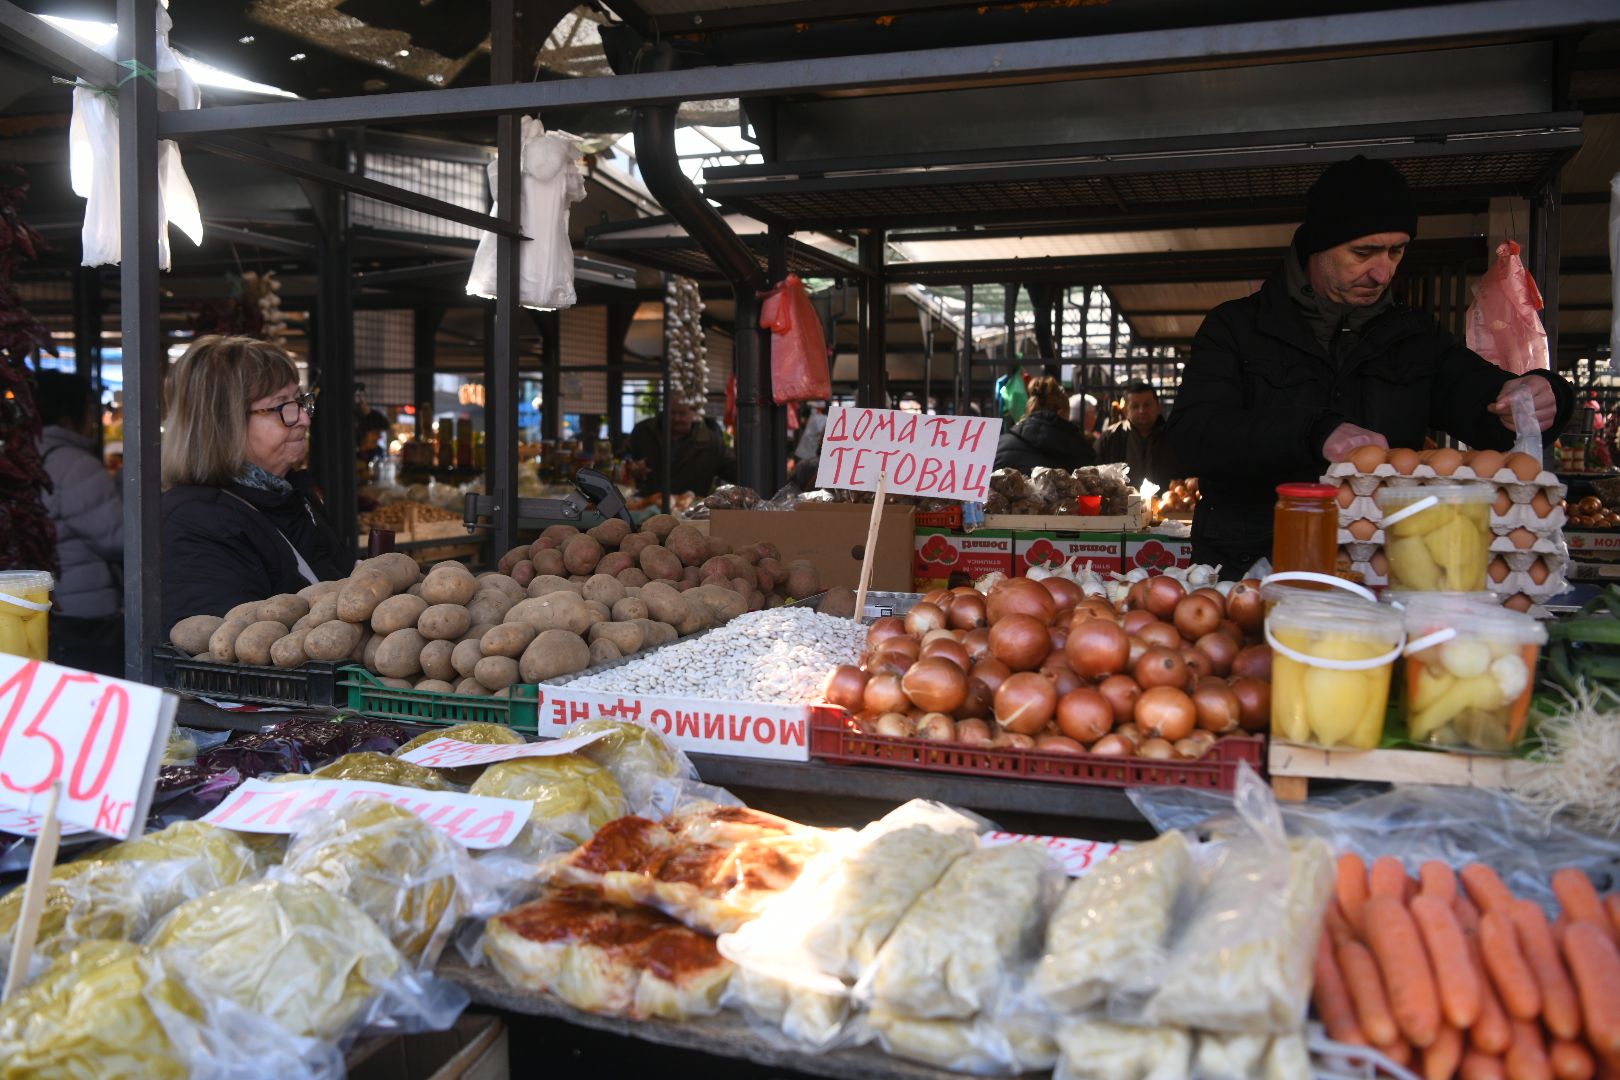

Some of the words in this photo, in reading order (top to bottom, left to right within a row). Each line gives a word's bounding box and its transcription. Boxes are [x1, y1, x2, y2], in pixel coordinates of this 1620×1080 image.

[827, 408, 986, 452] ДОМАЋИ
[830, 447, 987, 498] ТЕТОВАЦ
[961, 540, 1008, 551] Domati
[1069, 544, 1118, 555] Domati
[0, 660, 130, 801] 150
[551, 699, 590, 724] НЕ
[650, 708, 806, 747] МОЛИМО
